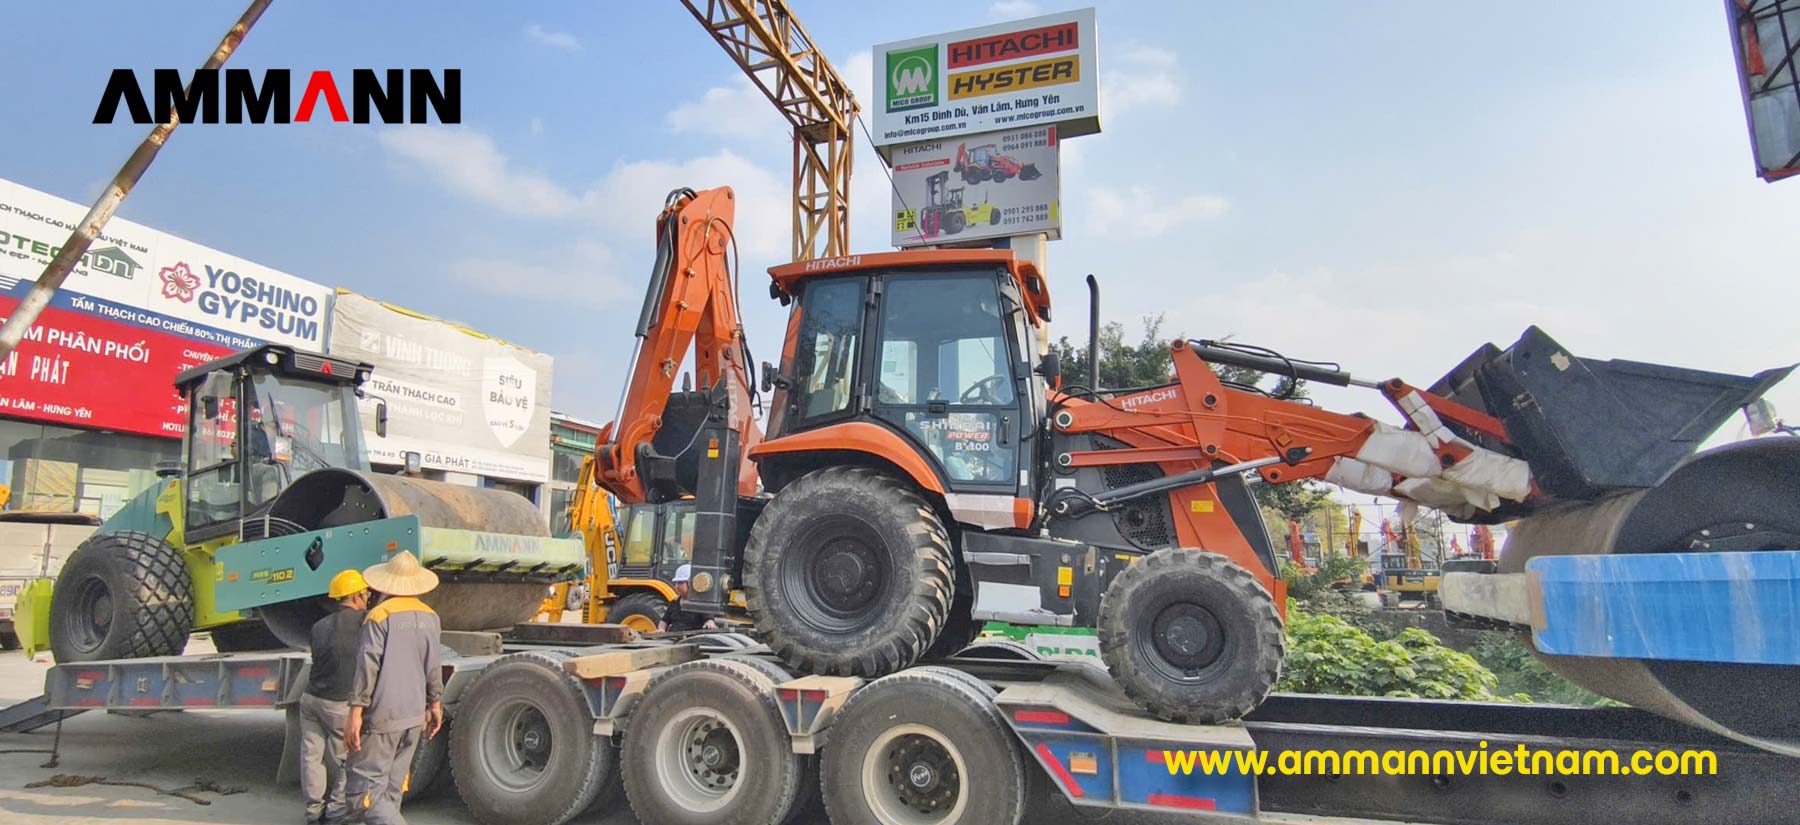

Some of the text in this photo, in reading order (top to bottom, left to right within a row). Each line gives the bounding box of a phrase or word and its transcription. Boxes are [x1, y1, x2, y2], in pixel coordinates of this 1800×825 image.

[952, 28, 1073, 63] HITACHI
[953, 60, 1073, 95] HYSTER
[905, 111, 930, 125] Km15
[991, 101, 1013, 114] Lâm,
[1042, 94, 1060, 106] Yên
[911, 95, 932, 104] GROUP
[884, 122, 967, 139] info@micogroup.com.vn
[994, 105, 1084, 124] www.micogroup.com.vn
[904, 143, 942, 154] HITACHI
[45, 216, 63, 228] CAO
[129, 243, 148, 254] NAM
[806, 256, 861, 271] HITACHI
[204, 265, 318, 317] YOSHINO
[98, 303, 136, 320] THẠCH
[138, 314, 161, 327] CAO
[162, 319, 194, 335] CHIẾM
[194, 328, 215, 341] 80%
[199, 291, 318, 341] GYPSUM
[47, 328, 102, 355] PHÂN
[104, 340, 150, 364] PHỐI
[31, 354, 70, 385] PHÁT
[12, 398, 35, 411] LÂM
[43, 403, 72, 417] HƯNG
[74, 406, 92, 419] YÊN
[402, 386, 436, 402] THẠCH
[436, 394, 456, 407] CAO
[1121, 389, 1177, 409] HITACHI
[948, 431, 989, 440] POWER
[424, 453, 442, 465] GIA
[445, 455, 470, 469] PHÁT
[474, 534, 541, 553] AMMANN
